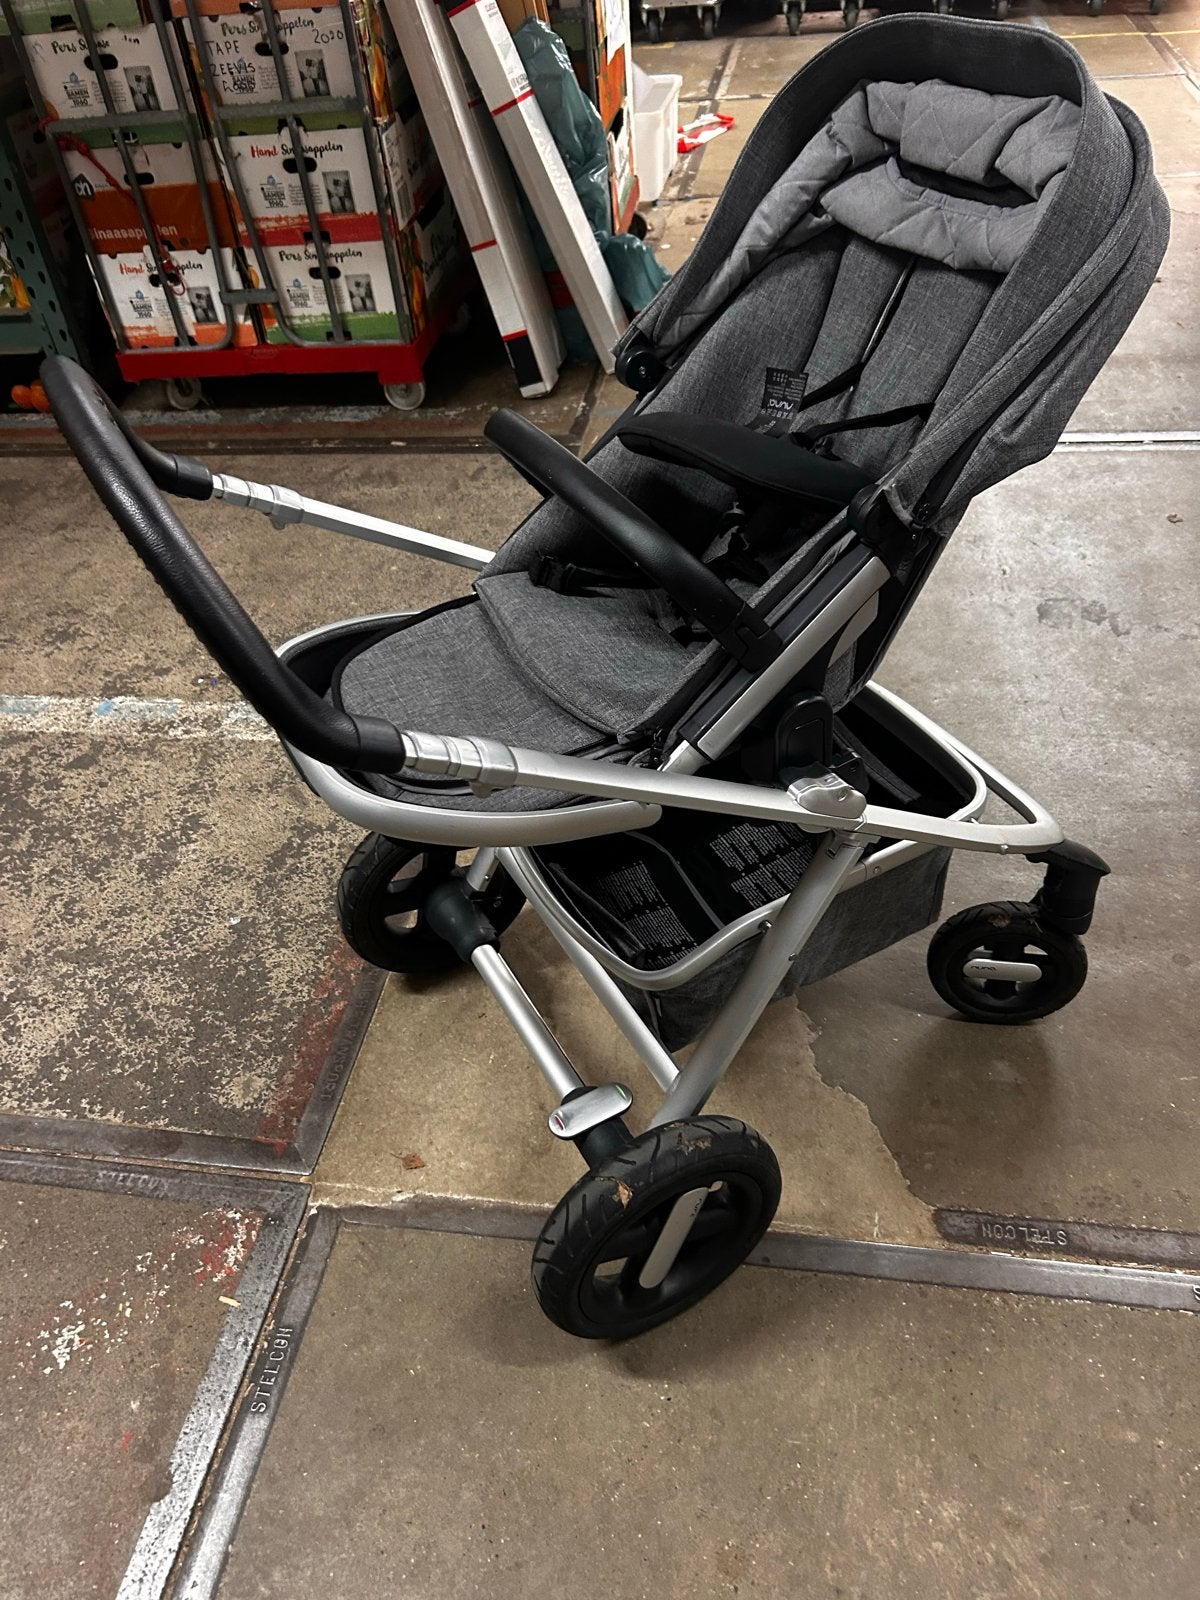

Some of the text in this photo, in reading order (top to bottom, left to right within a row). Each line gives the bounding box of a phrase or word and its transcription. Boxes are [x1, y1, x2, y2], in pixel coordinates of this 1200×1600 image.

[221, 22, 247, 37] Pers
[312, 28, 344, 44] 2020
[51, 39, 77, 54] Pers
[205, 40, 239, 57] TAPE
[251, 145, 279, 158] Hand
[89, 224, 178, 242] inaasaplen
[279, 250, 303, 262] Pers
[119, 262, 144, 275] Hand
[251, 1327, 293, 1414] STELCON
